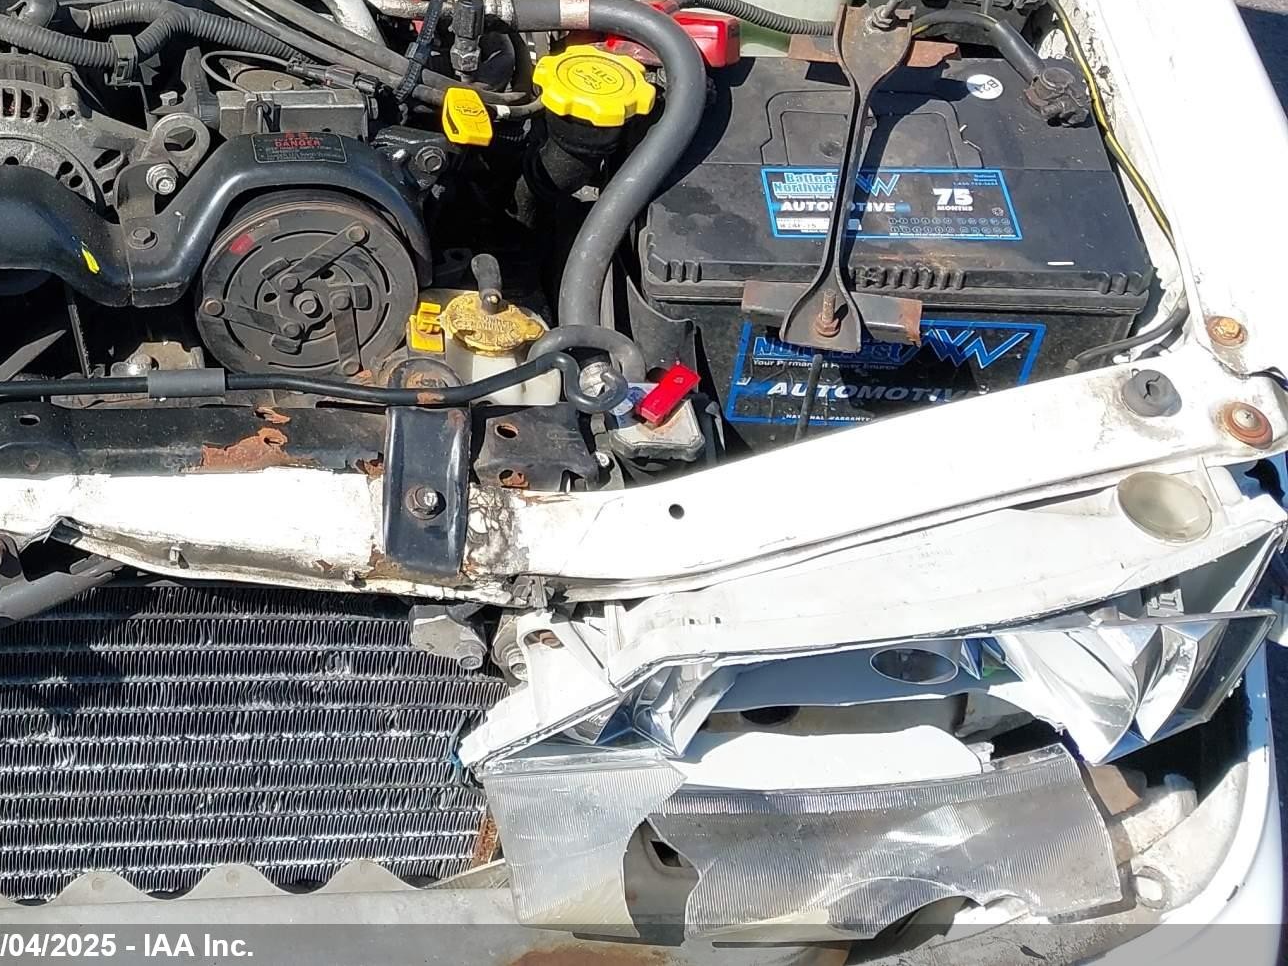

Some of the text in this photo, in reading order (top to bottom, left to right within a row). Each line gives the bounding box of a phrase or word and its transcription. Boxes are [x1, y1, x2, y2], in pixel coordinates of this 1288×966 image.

[274, 139, 321, 147] DANGER
[932, 188, 974, 206] 75
[753, 359, 775, 367] Your
